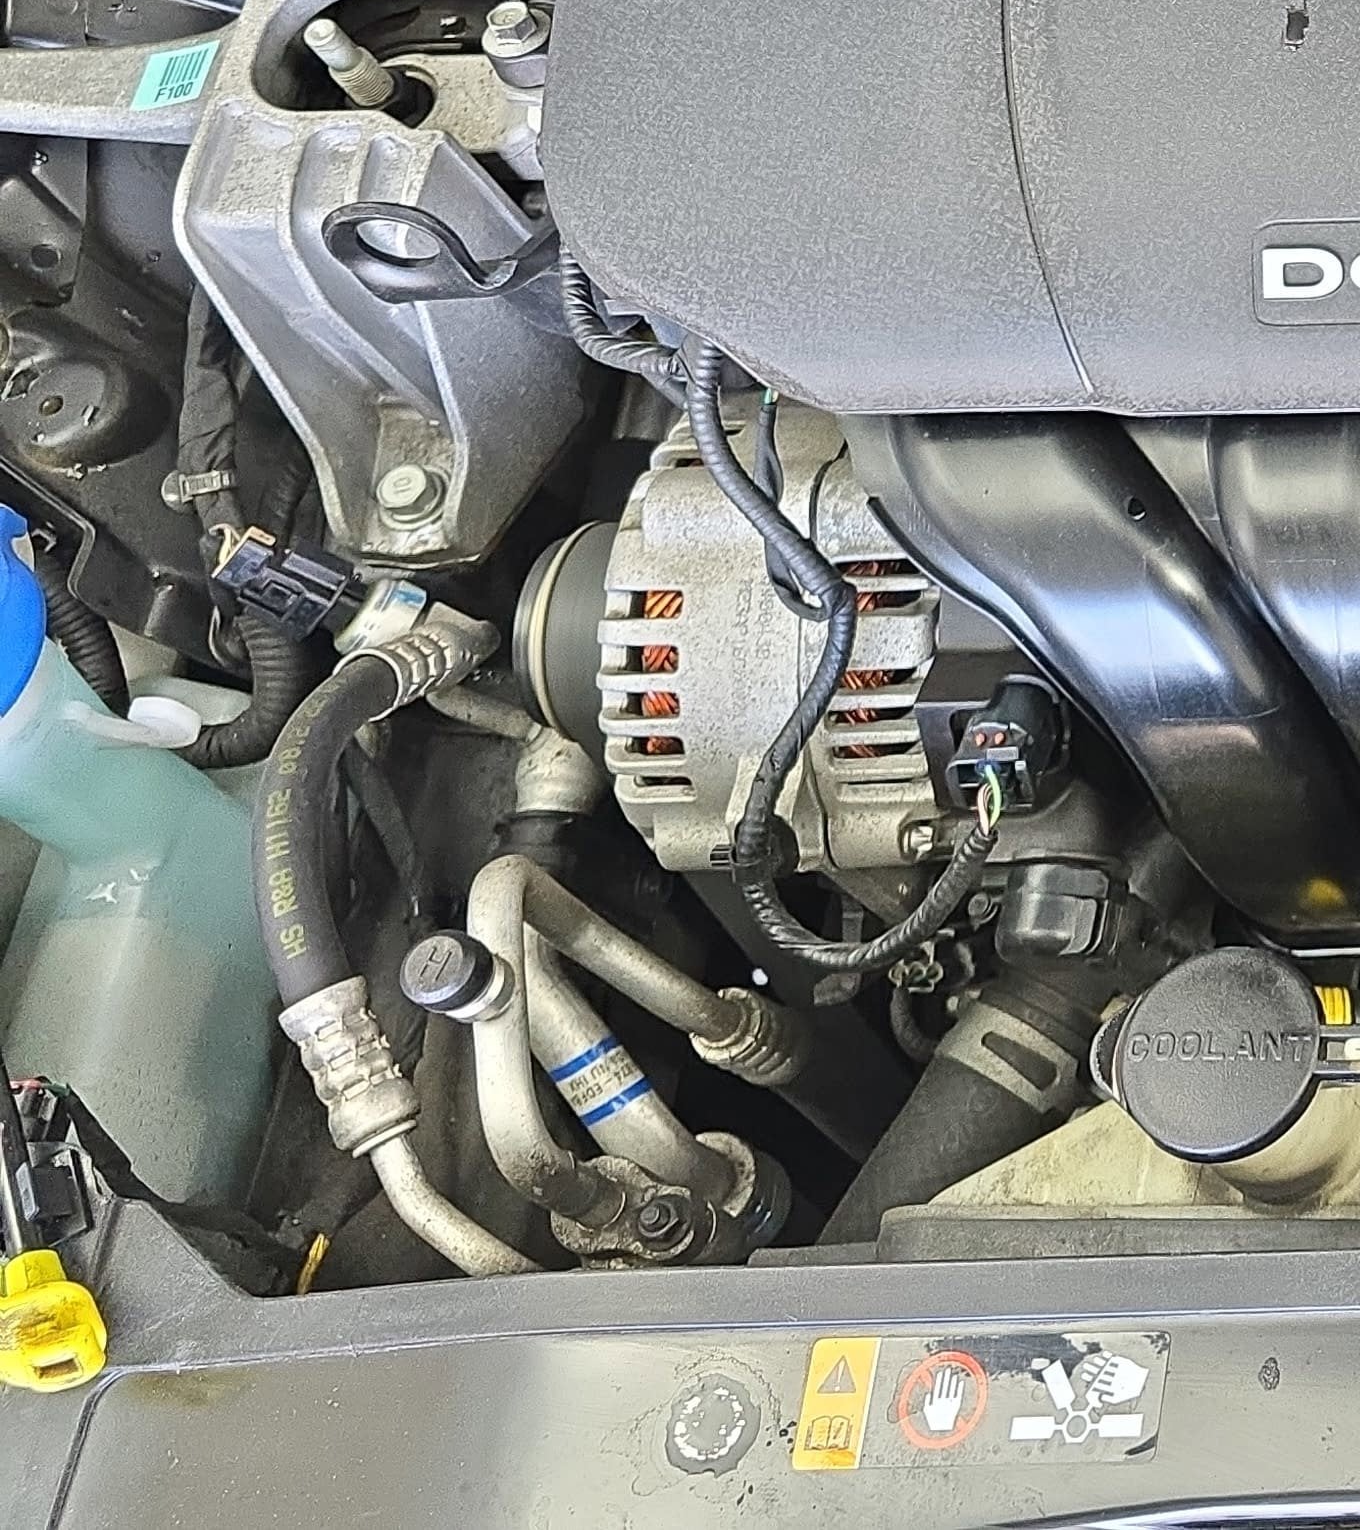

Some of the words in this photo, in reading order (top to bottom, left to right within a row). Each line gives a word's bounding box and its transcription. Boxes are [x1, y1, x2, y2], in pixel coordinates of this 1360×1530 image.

[153, 81, 194, 103] F100
[279, 923, 308, 961] HS
[1126, 1029, 1313, 1064] COOLANT
